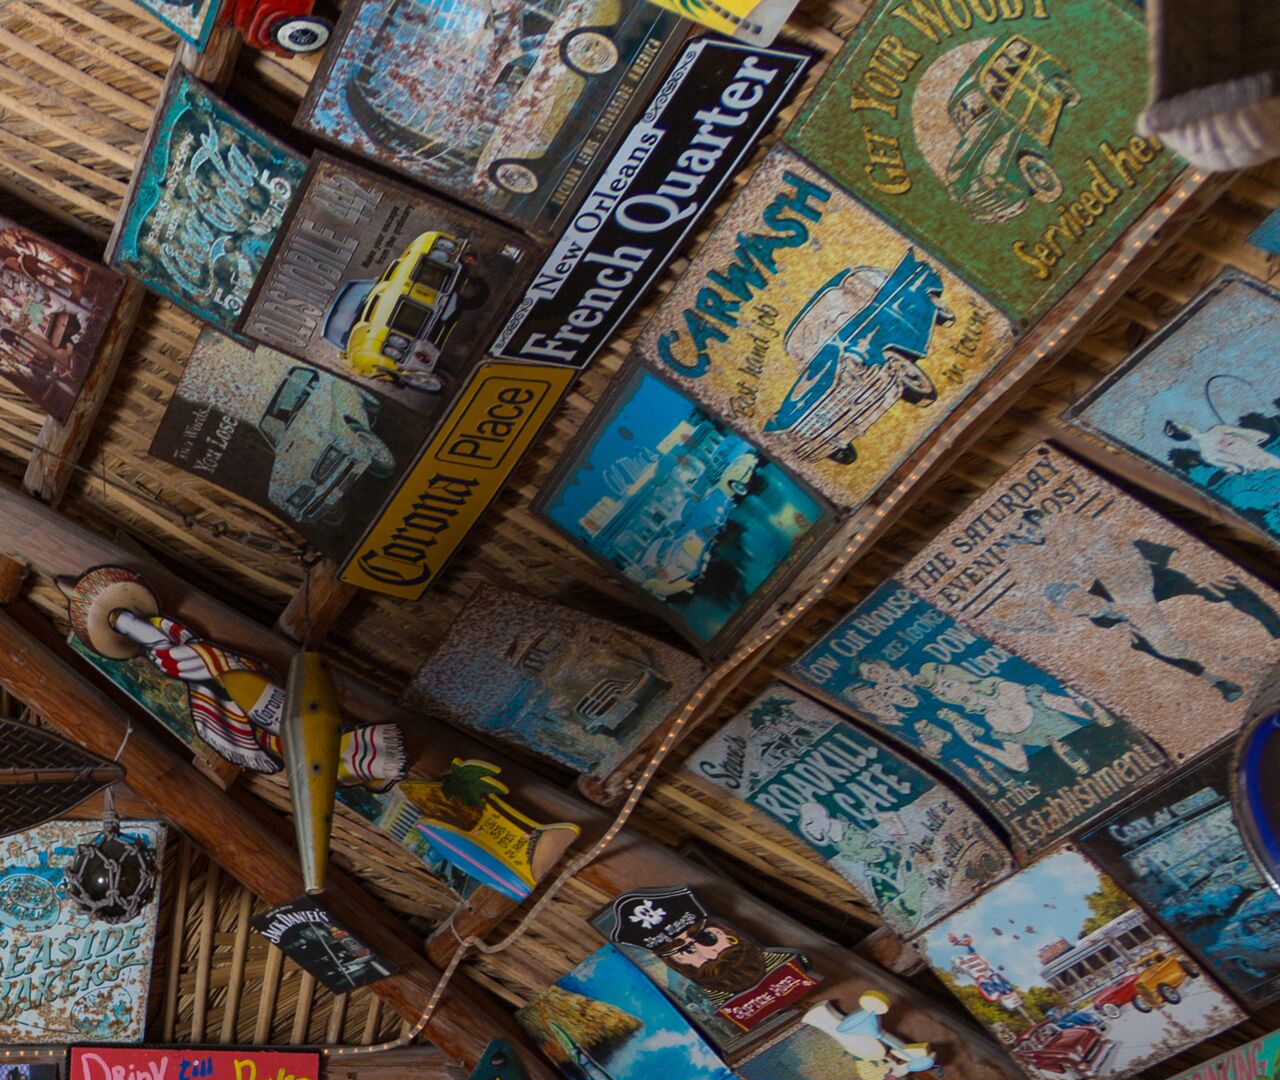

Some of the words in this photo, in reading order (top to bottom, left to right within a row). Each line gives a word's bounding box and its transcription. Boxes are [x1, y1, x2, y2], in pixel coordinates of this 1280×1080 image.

[851, 35, 922, 119] YOUR
[520, 246, 652, 363] French
[615, 56, 780, 234] Quarter
[534, 241, 578, 299] New
[574, 132, 659, 233] Orleans
[864, 125, 912, 194] GET
[1012, 159, 1119, 281] Serviced
[657, 170, 831, 378] CARWASH
[357, 472, 480, 586] Corona
[448, 387, 534, 461] Place
[911, 551, 952, 595] THE
[953, 454, 1061, 553] SATURDAY
[759, 732, 880, 823] ROADKILL
[261, 920, 286, 943] JACK
[278, 908, 329, 929] DANIEL'S
